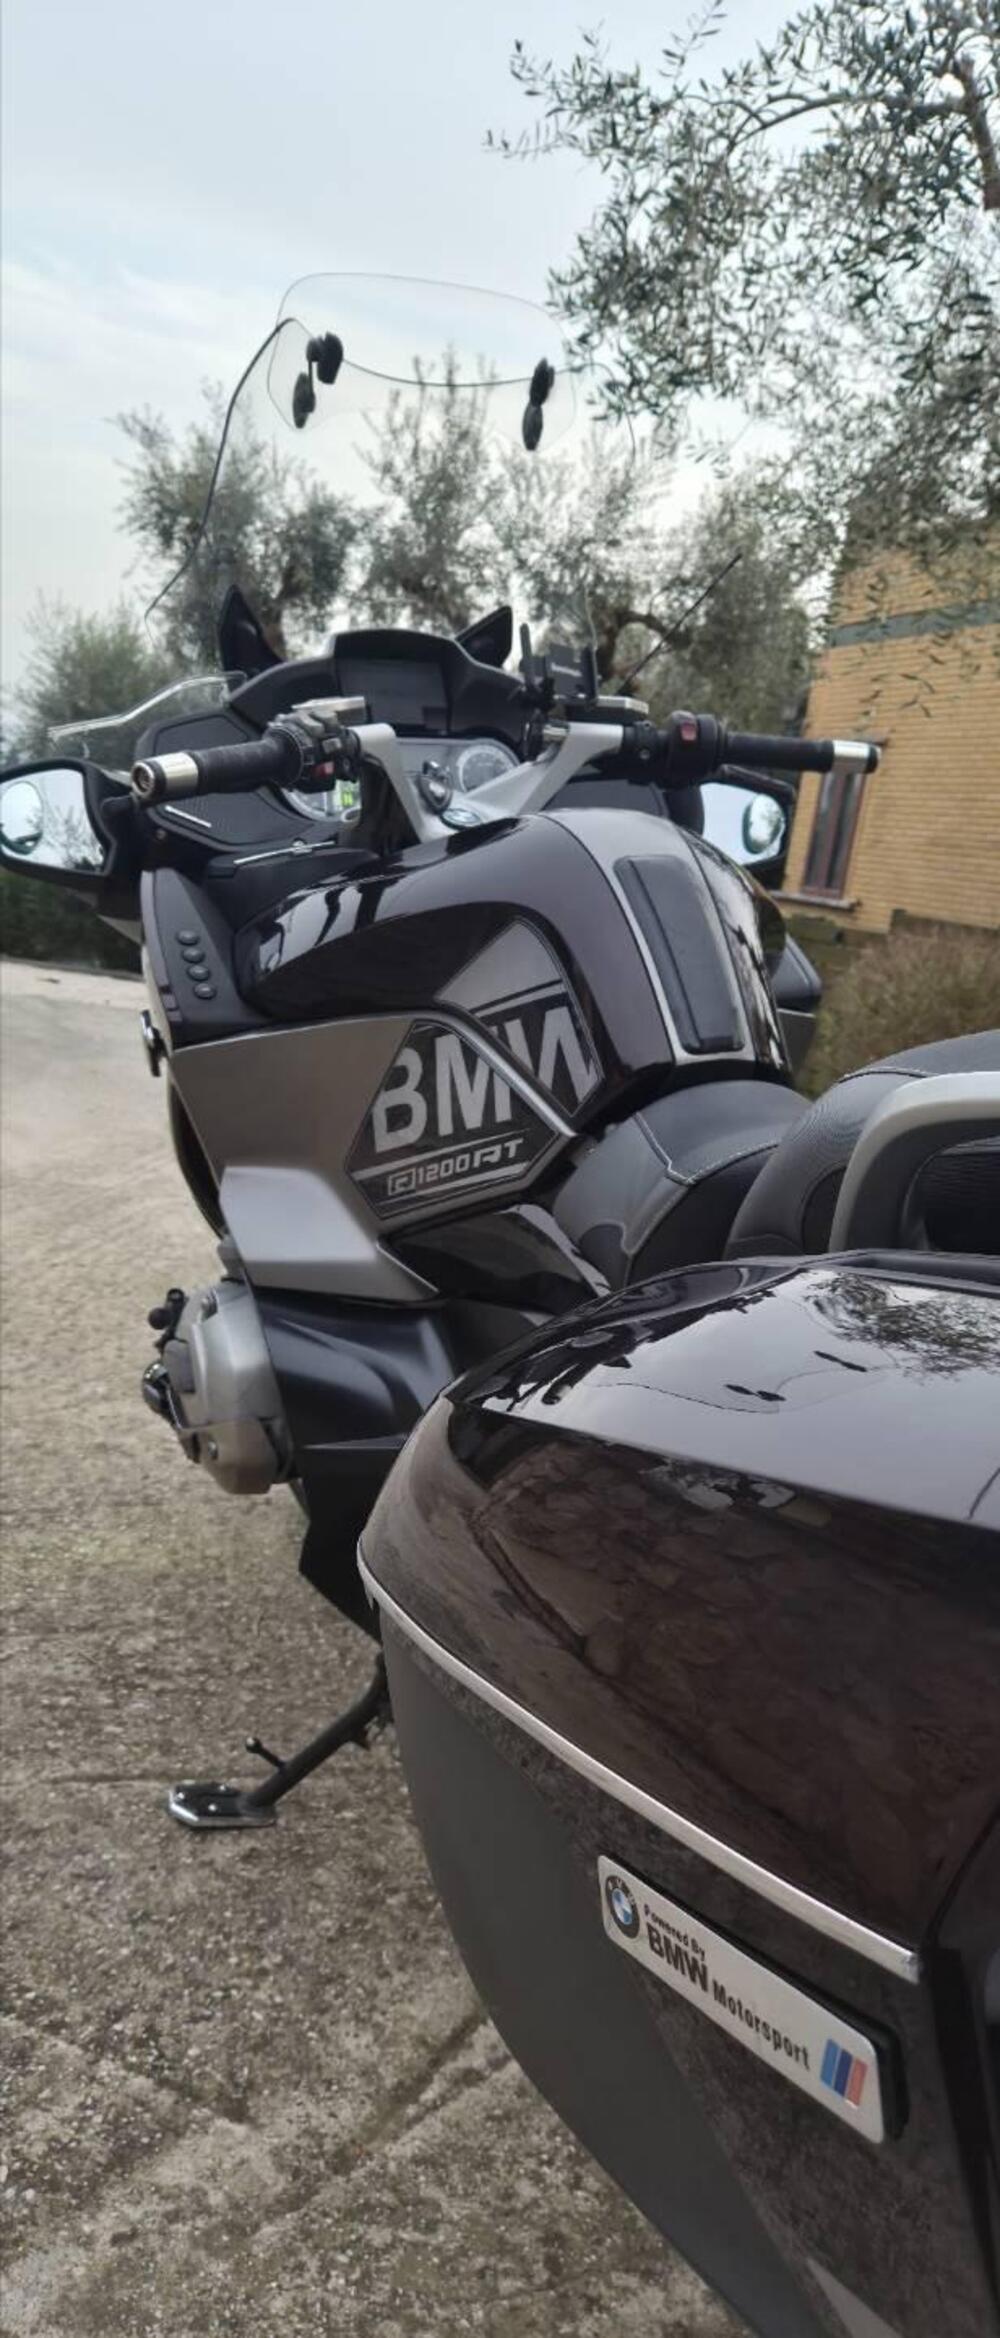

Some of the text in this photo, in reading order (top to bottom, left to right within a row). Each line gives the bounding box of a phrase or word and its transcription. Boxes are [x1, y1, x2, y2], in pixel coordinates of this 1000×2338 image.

[371, 1006, 599, 1153] BMW
[644, 1903, 705, 1962] Powered By
[646, 1921, 811, 2071] BMW Motorsport
